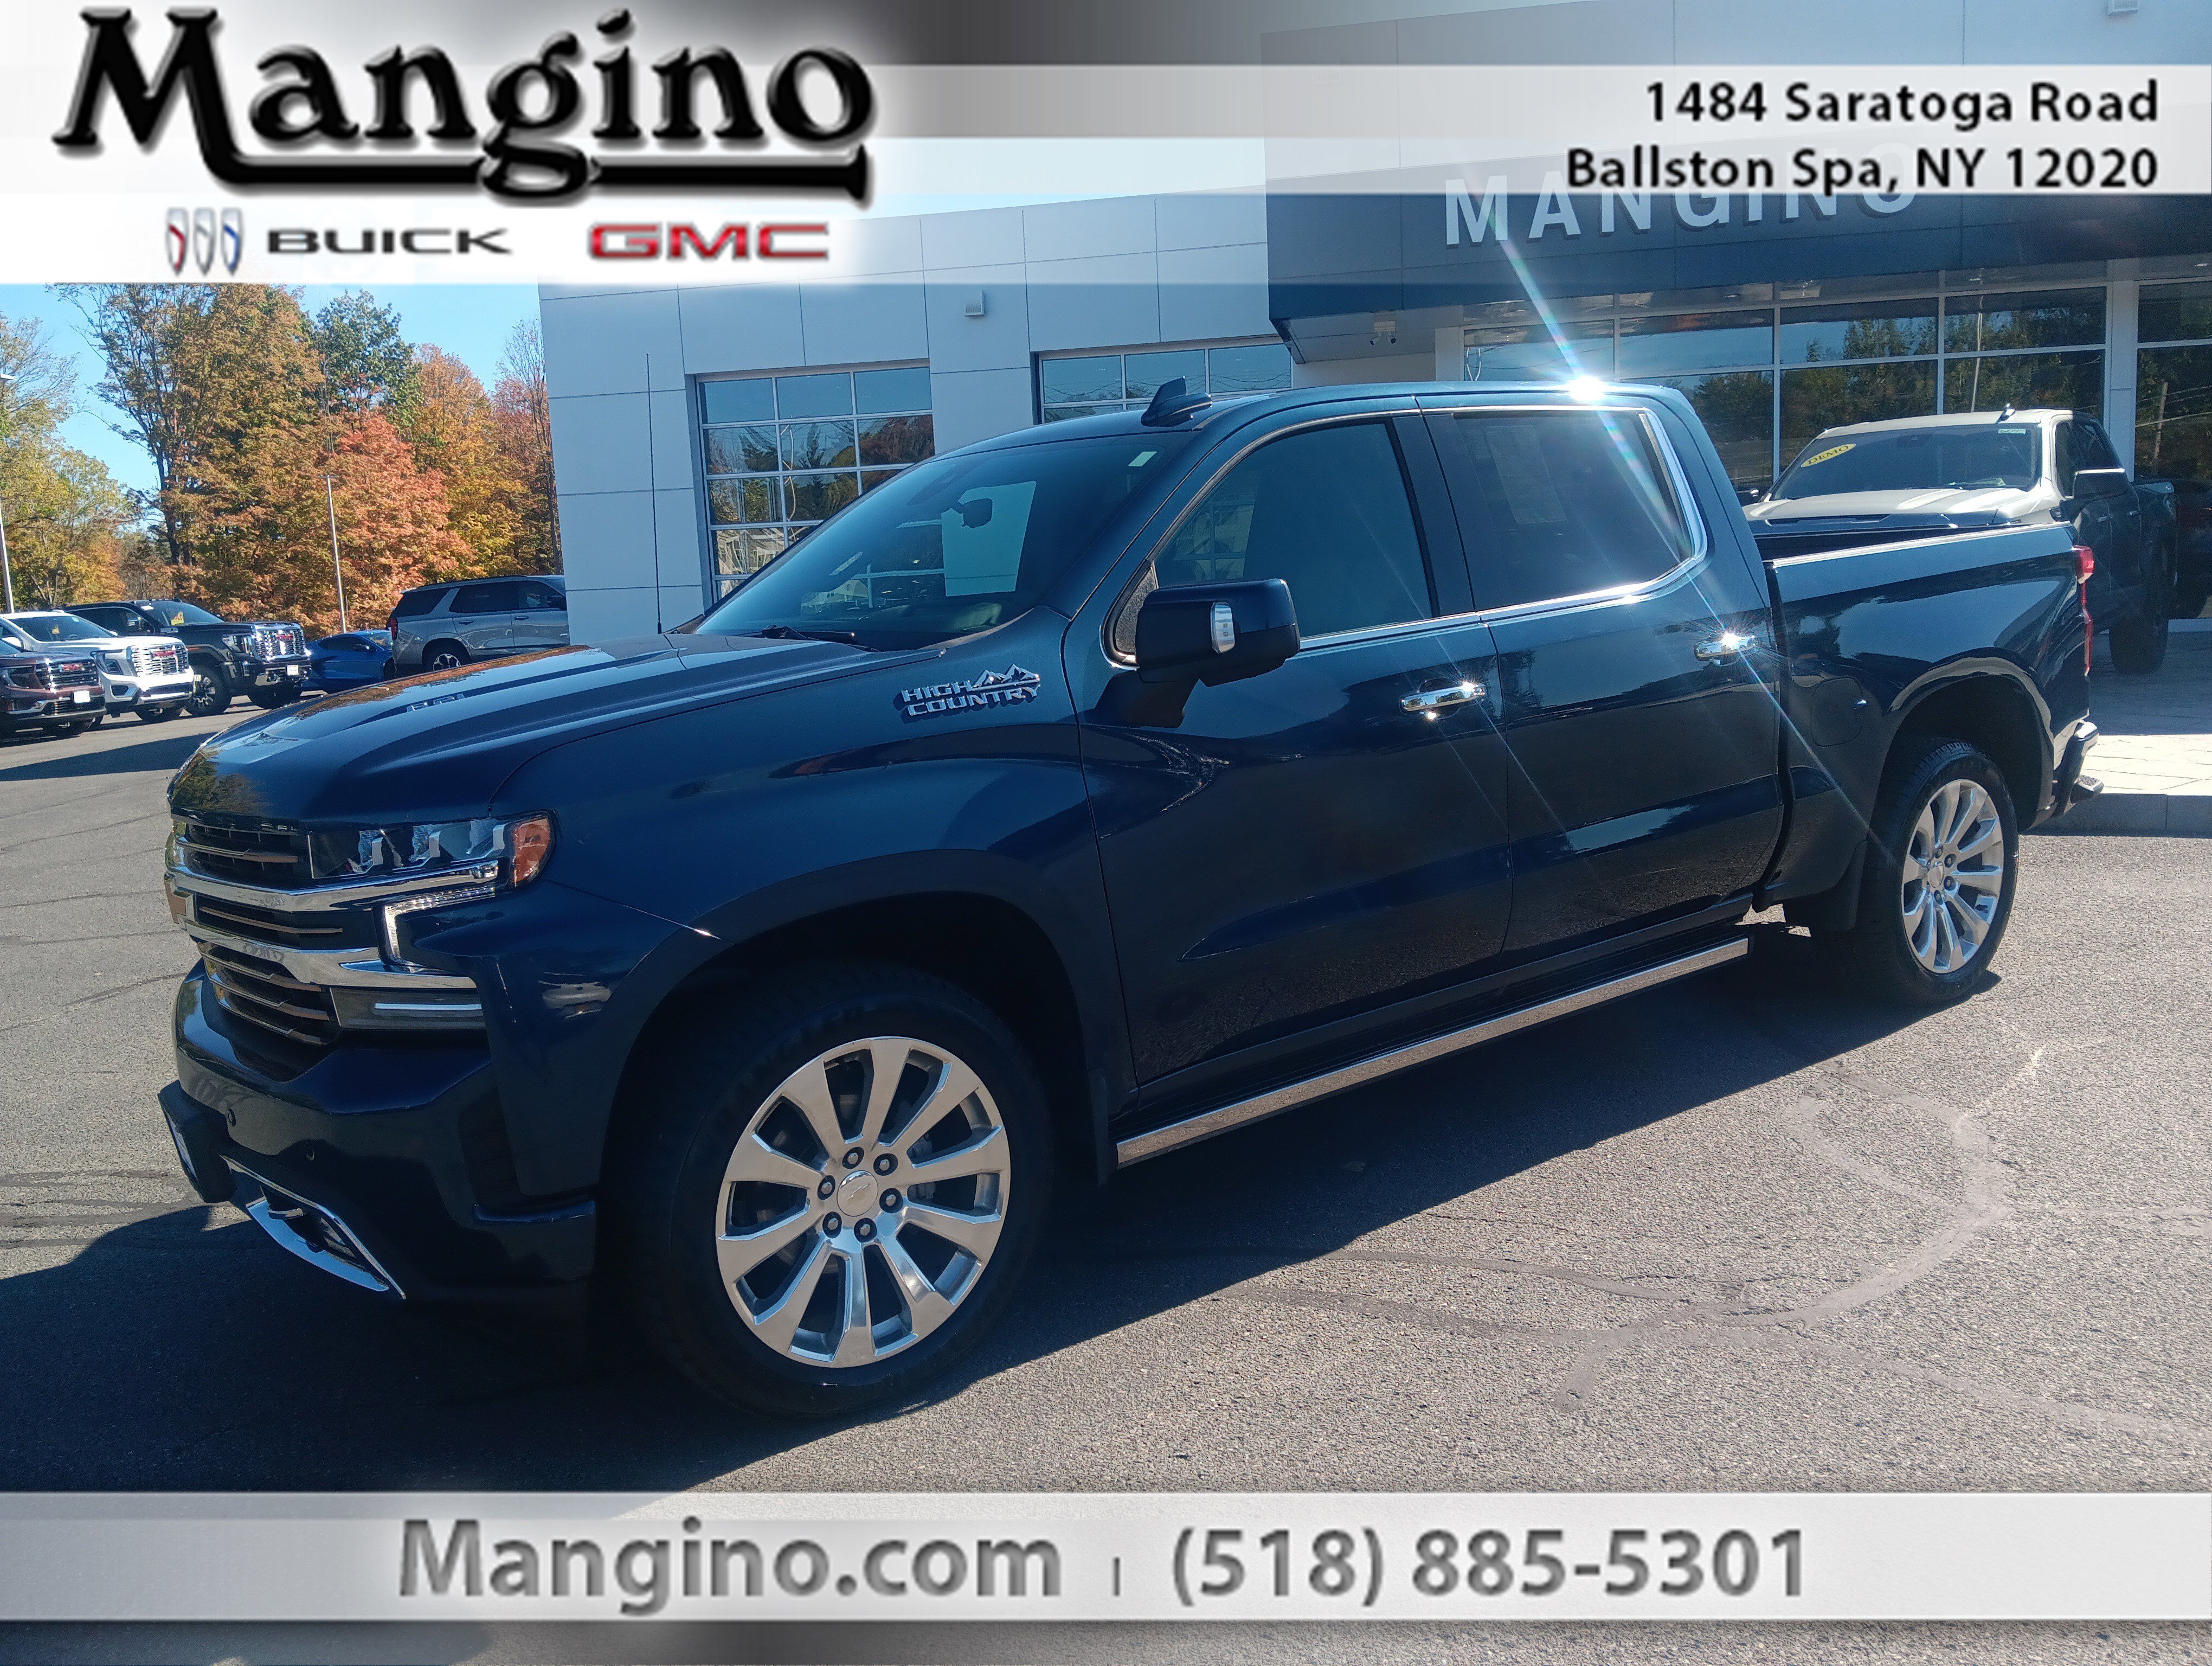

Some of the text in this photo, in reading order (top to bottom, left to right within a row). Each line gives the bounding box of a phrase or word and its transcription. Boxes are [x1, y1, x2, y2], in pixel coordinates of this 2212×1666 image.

[1444, 142, 1918, 246] MANGINO
[1808, 445, 1849, 465] DEMO
[901, 680, 974, 702] HIGH
[906, 684, 1041, 716] COUNTRY
